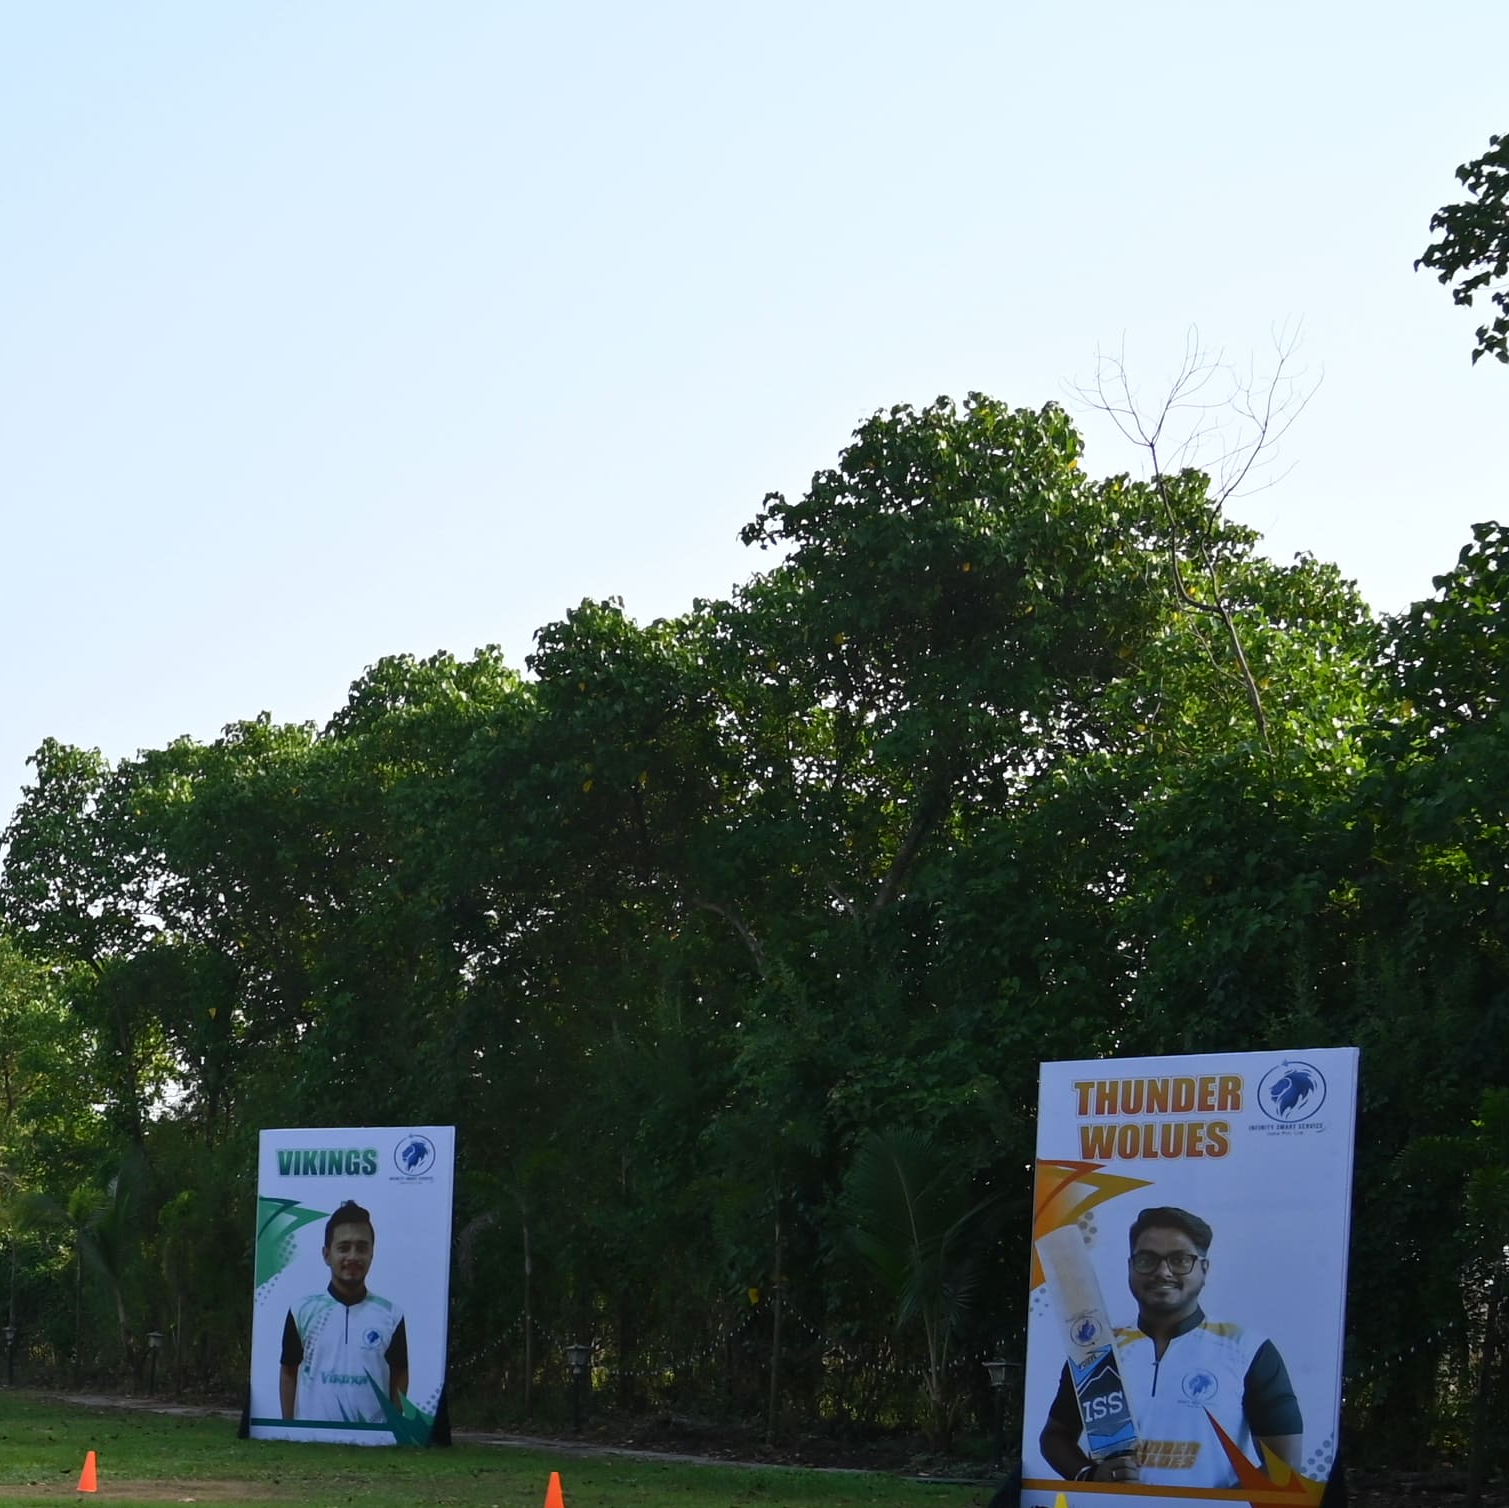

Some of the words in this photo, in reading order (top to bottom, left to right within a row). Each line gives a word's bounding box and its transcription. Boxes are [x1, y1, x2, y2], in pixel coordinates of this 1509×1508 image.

[1073, 1074, 1244, 1117] THUNDER
[1080, 1120, 1231, 1160] WOLUES
[277, 1148, 378, 1177] VIKINGS
[1082, 1390, 1124, 1423] ISS
